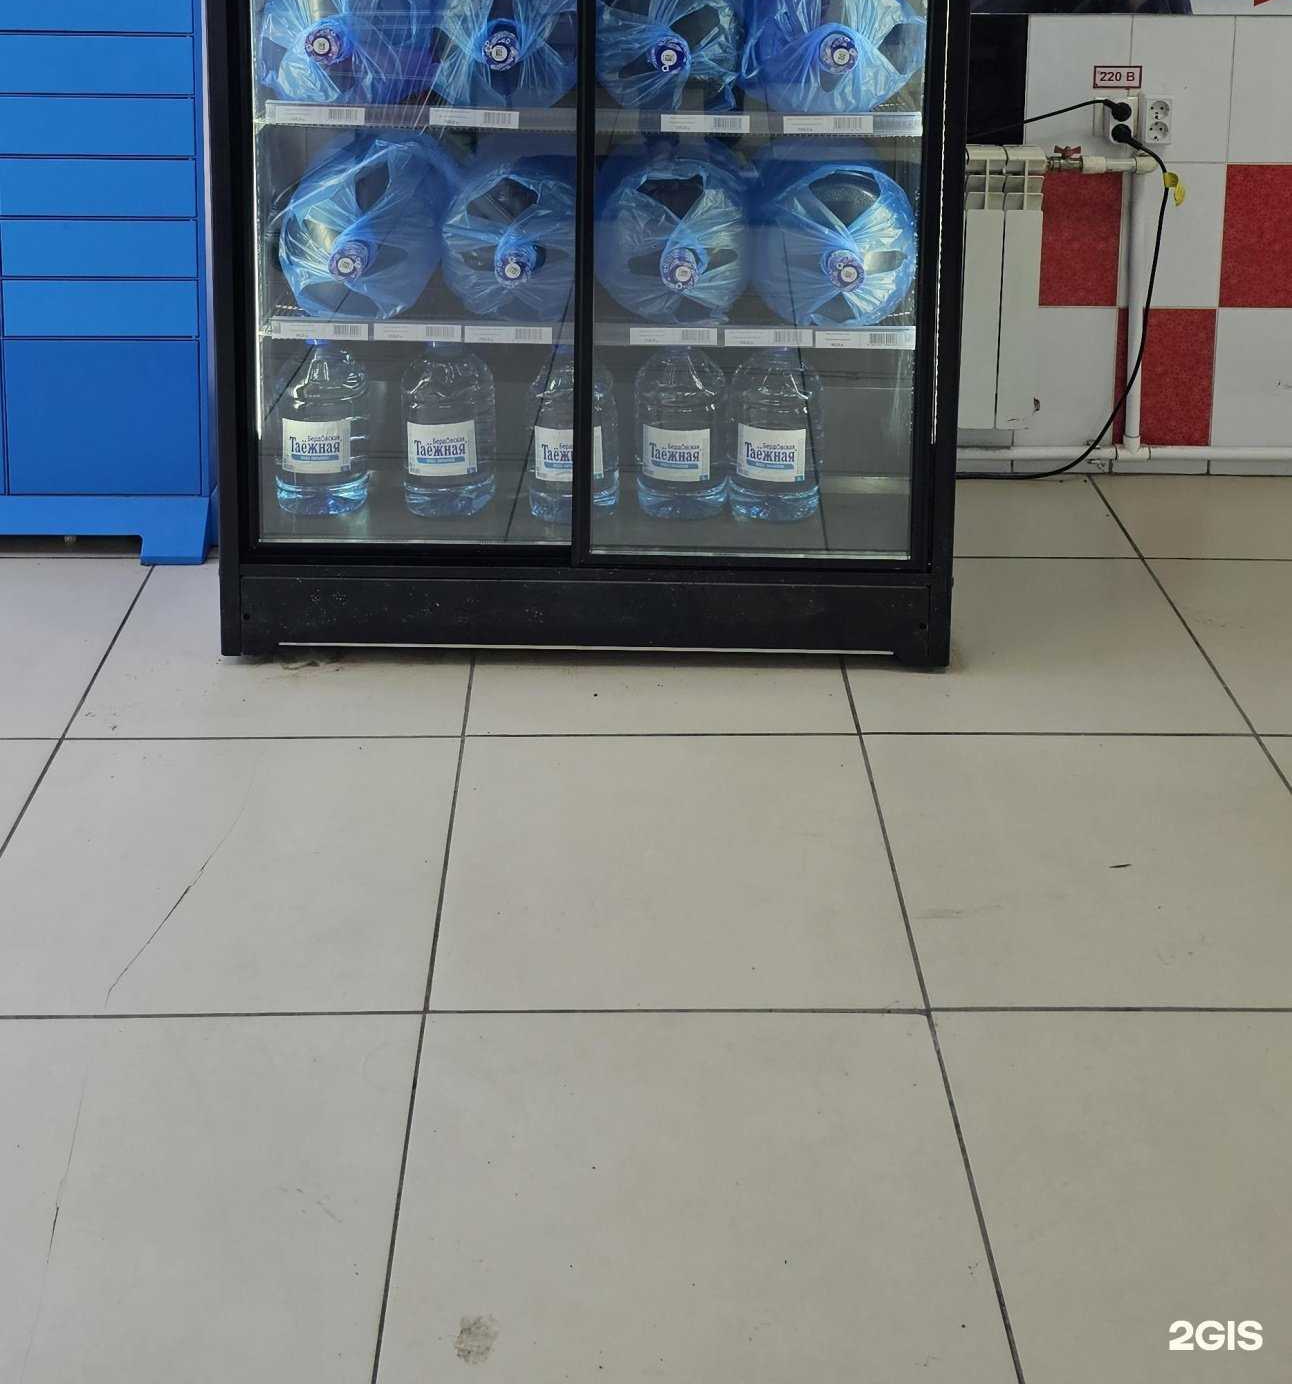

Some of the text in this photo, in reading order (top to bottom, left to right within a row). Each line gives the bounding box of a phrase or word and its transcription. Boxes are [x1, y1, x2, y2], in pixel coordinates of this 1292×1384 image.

[1100, 71, 1136, 82] 220 В
[289, 435, 340, 454] Таёжная
[413, 439, 466, 457] Таёжная
[648, 441, 700, 462] Таёжная
[744, 441, 795, 462] Таёжная
